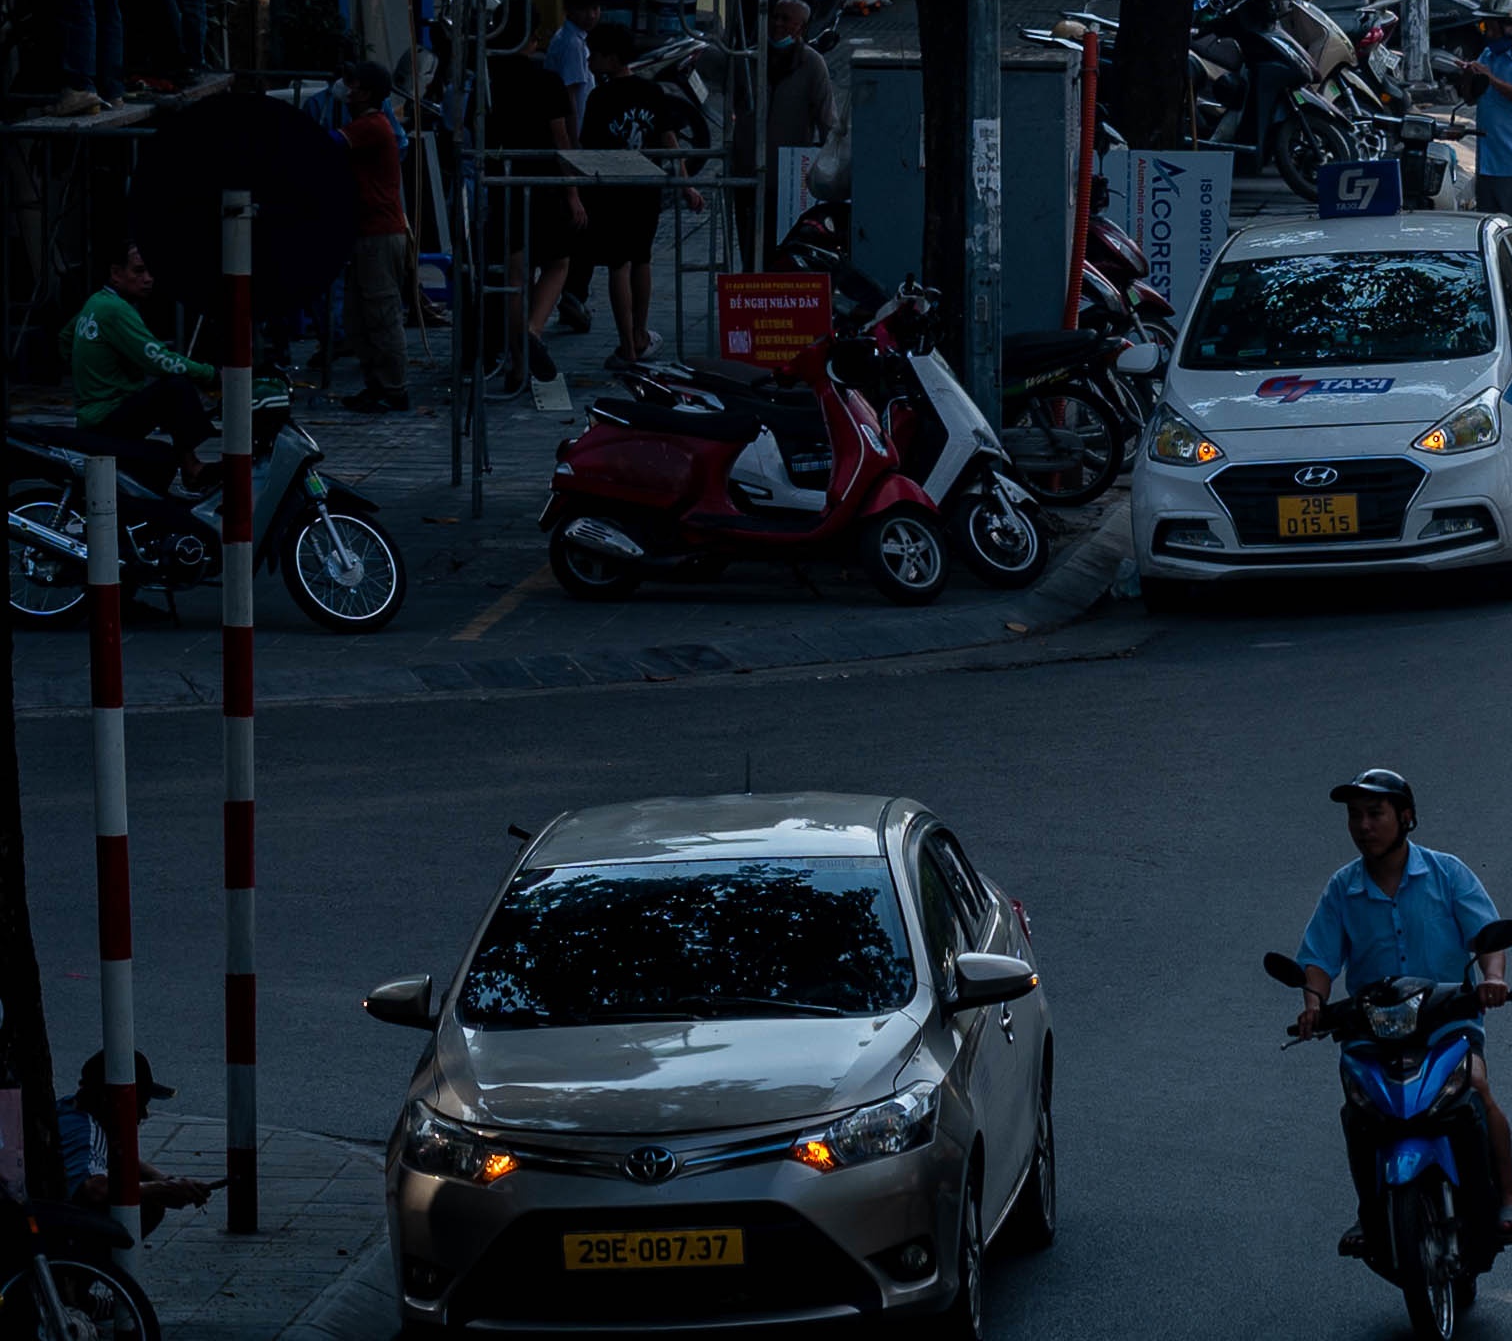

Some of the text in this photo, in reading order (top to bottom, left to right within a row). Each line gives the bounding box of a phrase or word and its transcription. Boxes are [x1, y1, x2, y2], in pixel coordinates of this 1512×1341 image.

[1200, 179, 1212, 206] ISO
[1338, 169, 1380, 210] G7
[744, 297, 768, 313] NGHỊ
[769, 294, 797, 309] NHÂN
[798, 294, 820, 309] DÂN
[143, 340, 188, 375] Grab
[1257, 375, 1388, 404] G7 TAXI
[1300, 498, 1335, 515] 29E
[1287, 516, 1351, 534] 015.15
[578, 1235, 729, 1264] 29E-087.37
